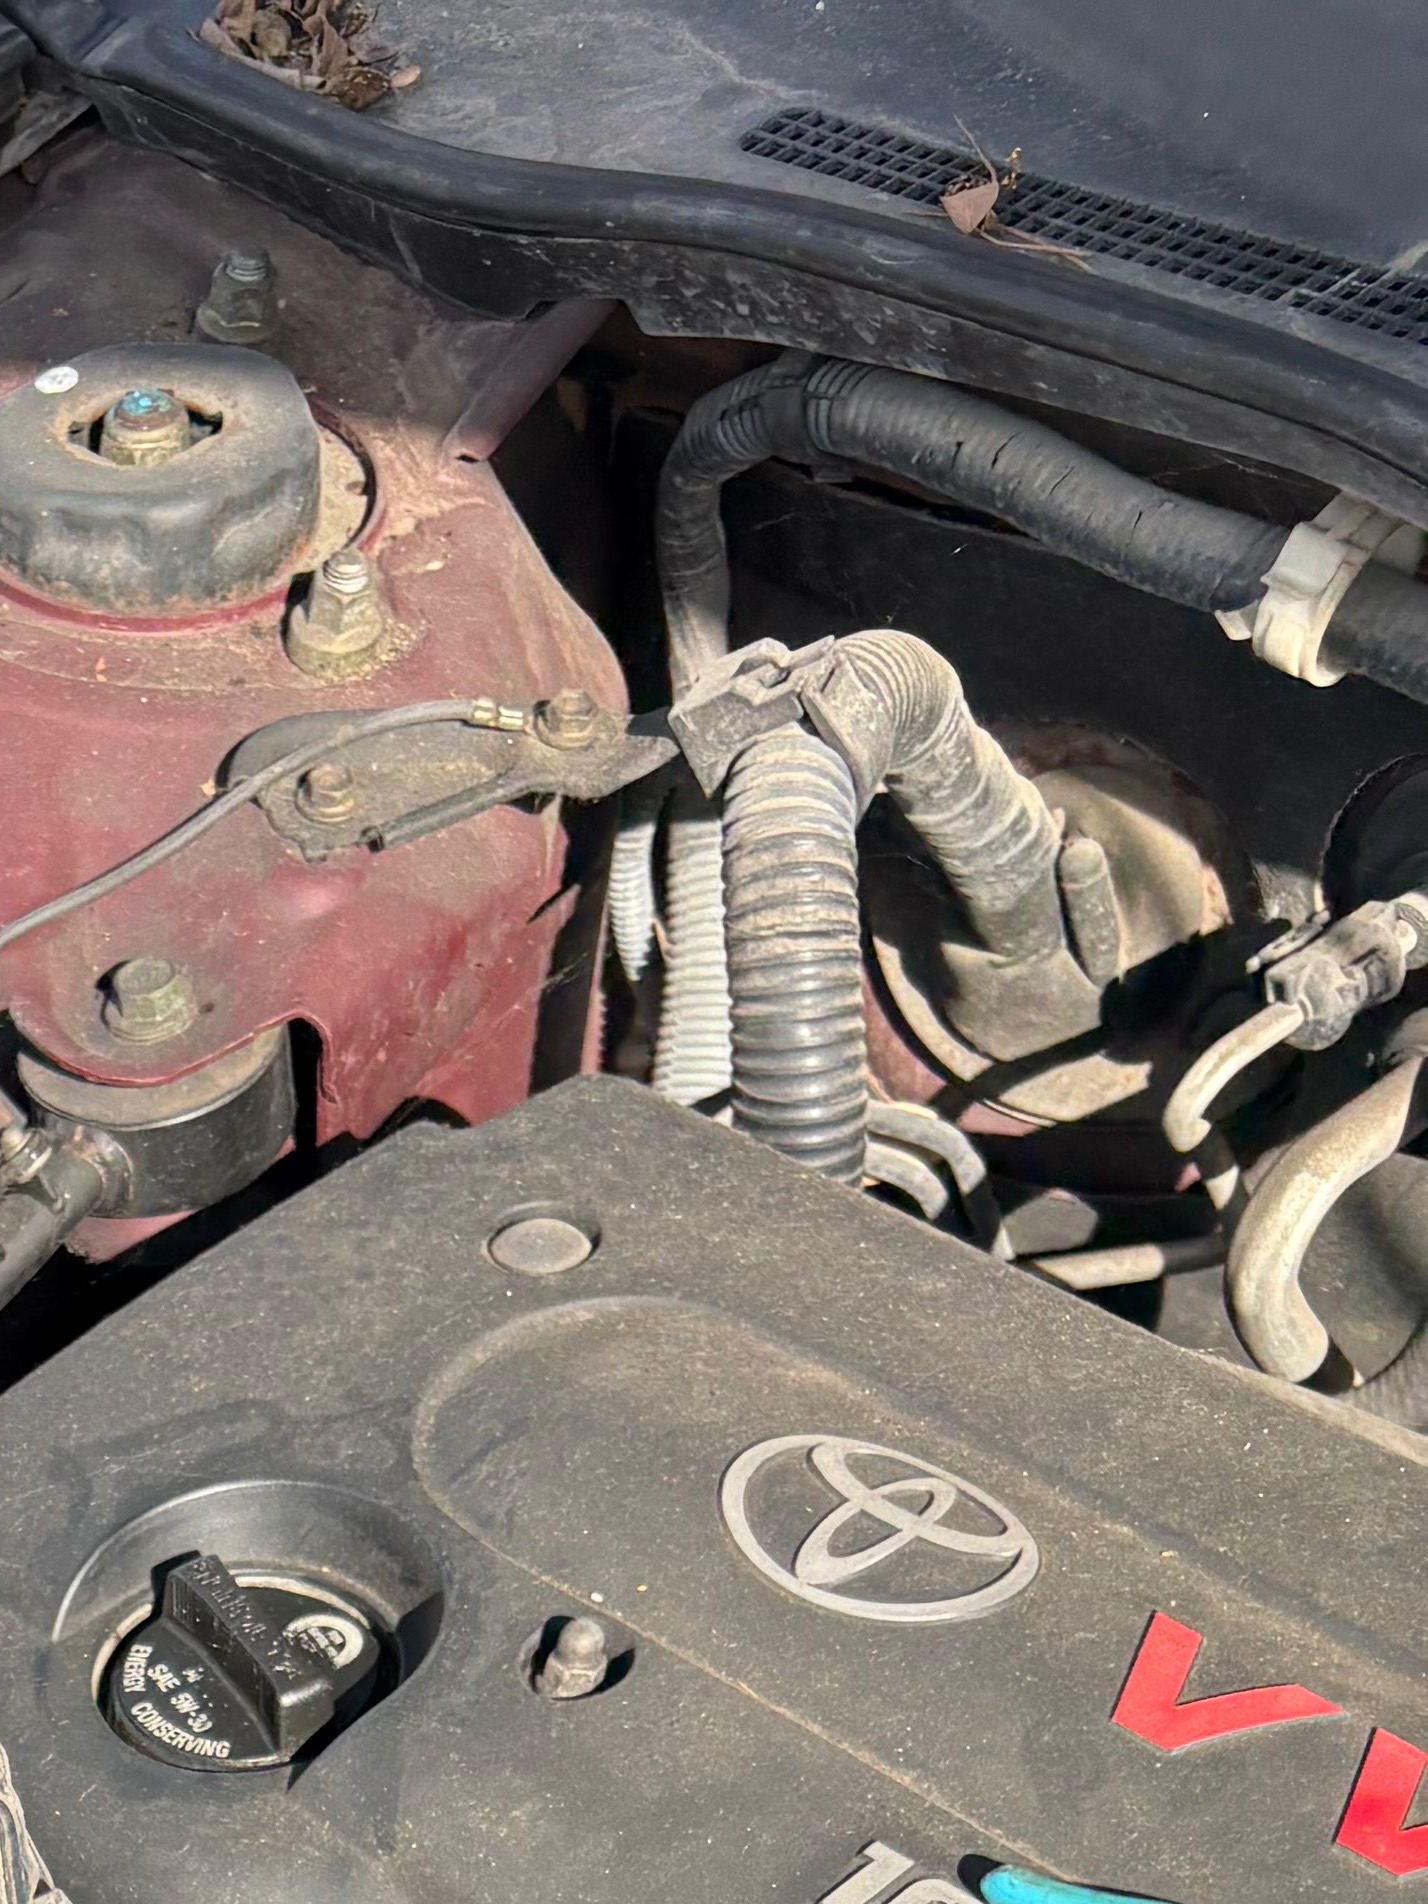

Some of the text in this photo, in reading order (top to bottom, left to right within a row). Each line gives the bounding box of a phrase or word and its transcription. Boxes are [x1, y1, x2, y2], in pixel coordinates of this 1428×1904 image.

[122, 1643, 231, 1758] ENERGY CONSERVING
[146, 1663, 181, 1692] SAE
[169, 1692, 212, 1732] 5W-30
